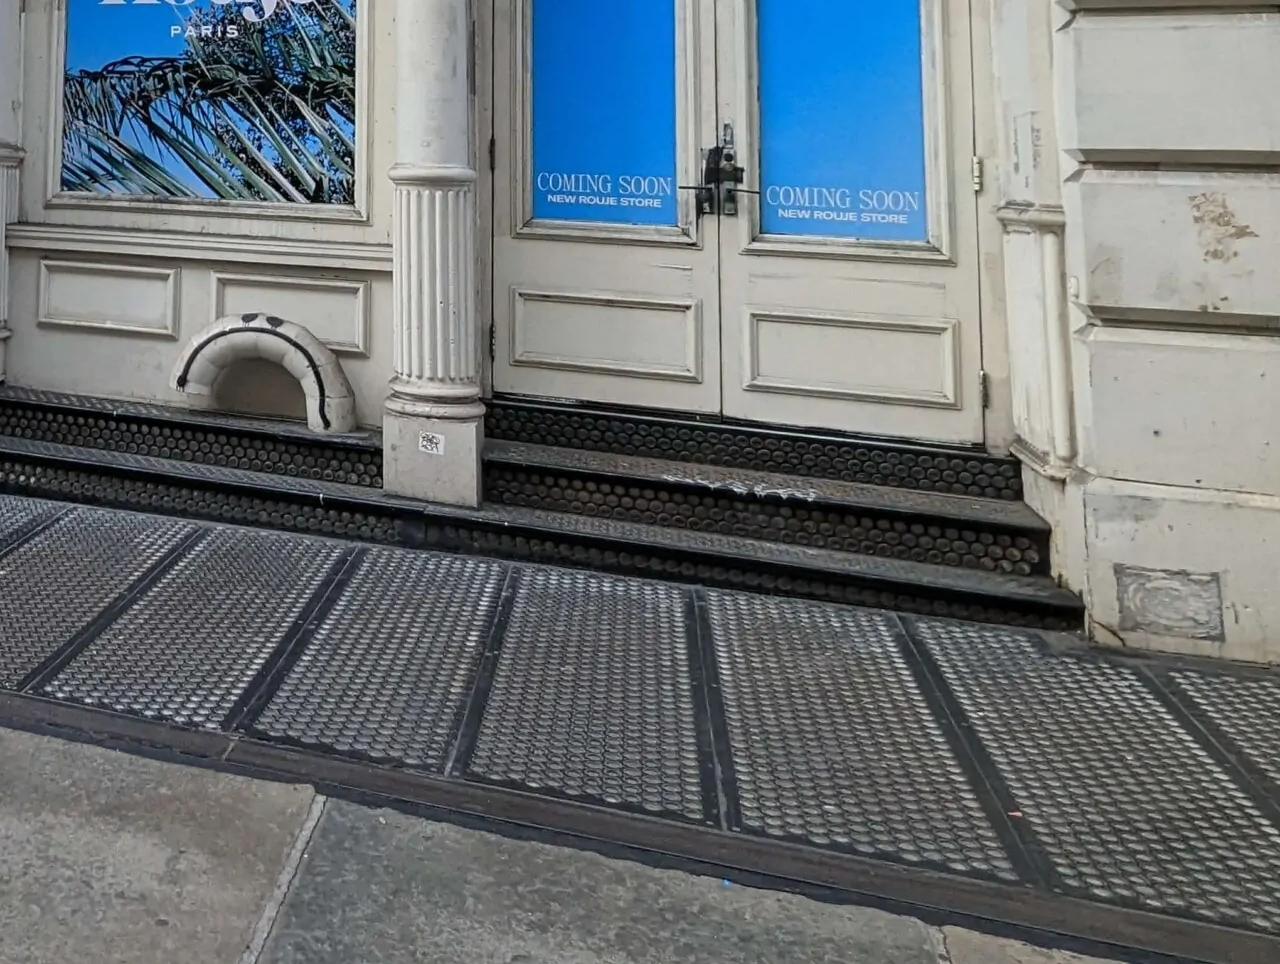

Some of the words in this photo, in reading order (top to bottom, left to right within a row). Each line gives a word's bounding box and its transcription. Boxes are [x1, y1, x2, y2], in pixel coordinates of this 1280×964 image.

[170, 25, 239, 38] PARIS
[537, 172, 612, 194] COMING
[619, 175, 673, 196] SOON
[547, 194, 576, 204] NEW
[578, 196, 618, 206] ROUJE
[619, 197, 663, 208] STORE
[766, 185, 852, 209] COMING
[858, 189, 920, 212] SOON
[778, 208, 811, 219] NEW
[860, 212, 909, 224] STORE
